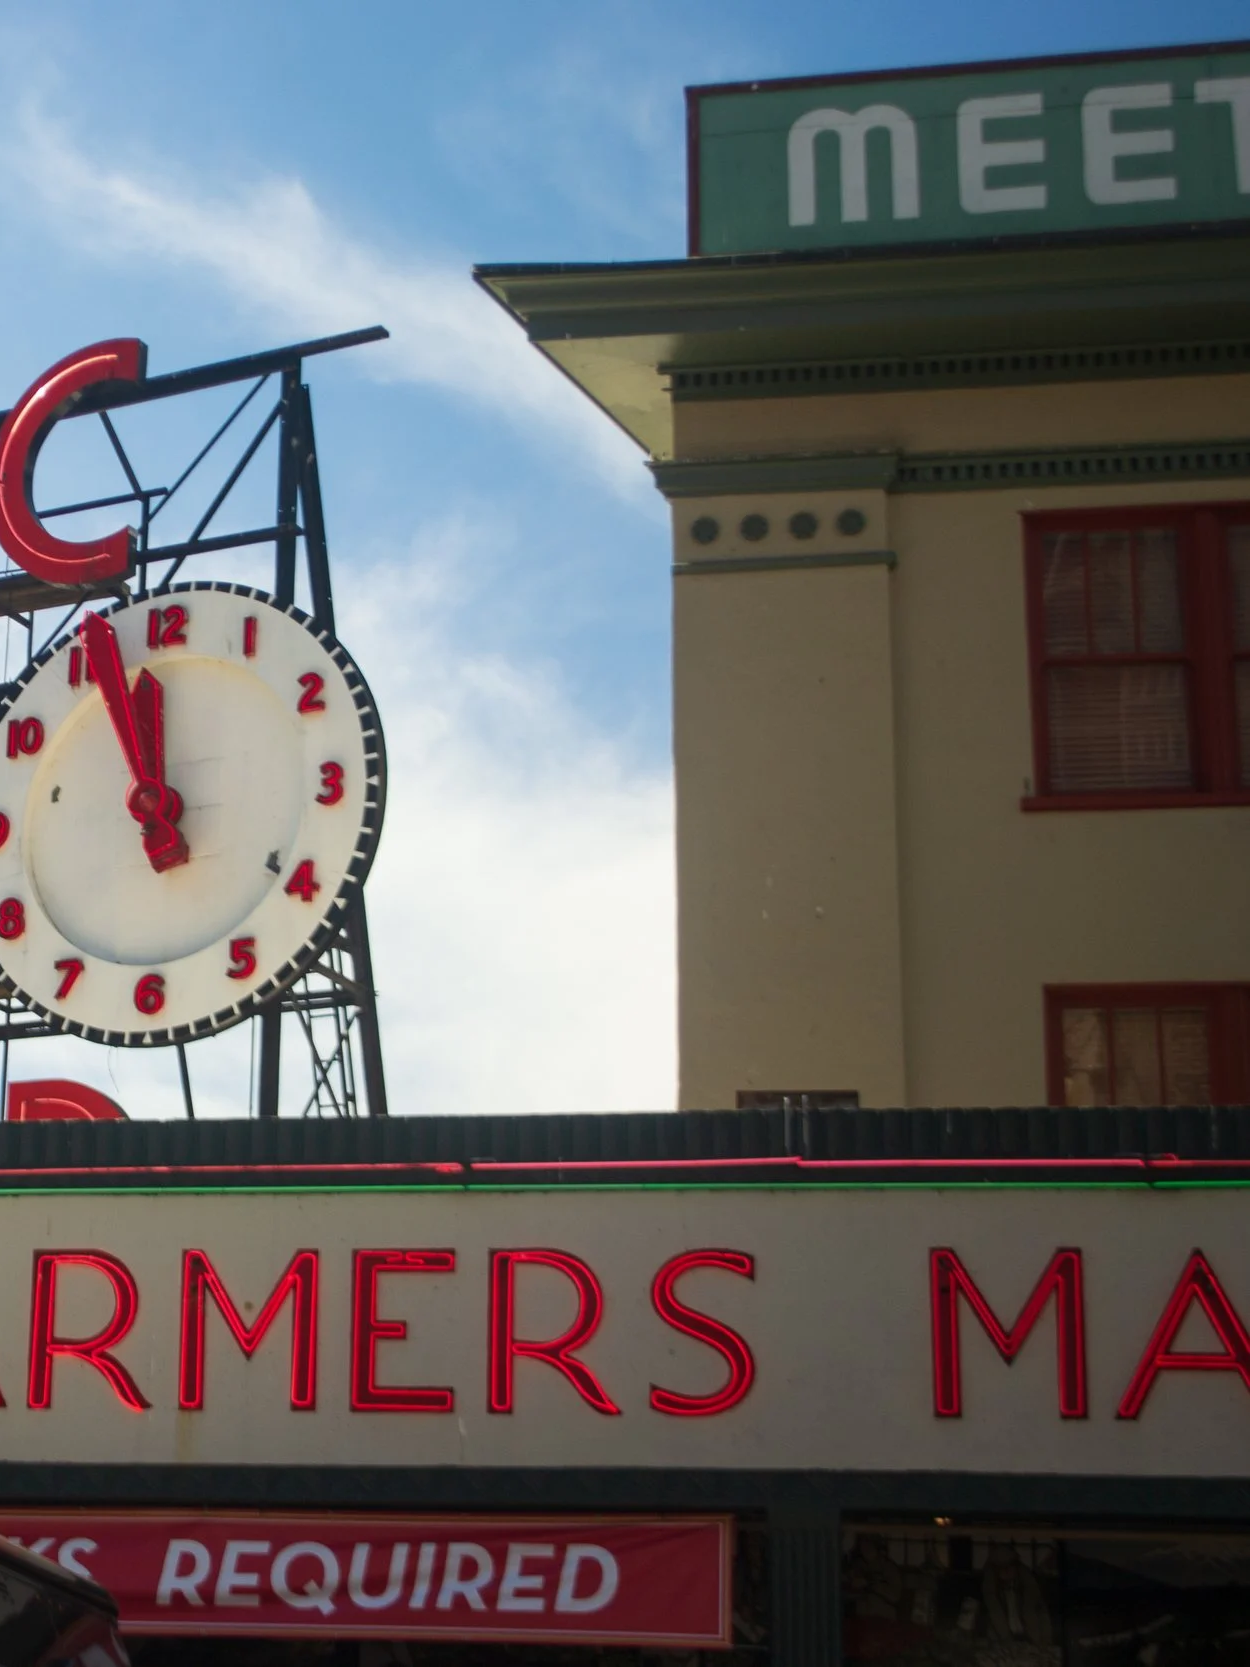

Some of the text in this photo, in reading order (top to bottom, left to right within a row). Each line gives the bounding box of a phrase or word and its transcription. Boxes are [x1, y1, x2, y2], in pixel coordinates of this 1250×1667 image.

[147, 604, 188, 649] 12
[243, 616, 258, 658] 1
[297, 672, 326, 714] 2
[7, 716, 44, 759] 10
[315, 761, 345, 806] 3
[284, 859, 320, 902] 4
[54, 958, 85, 1001] 7
[226, 937, 257, 980] 5
[133, 973, 166, 1015] 6
[928, 1246, 1250, 1420] MA
[155, 1538, 619, 1617] REQUIRED
